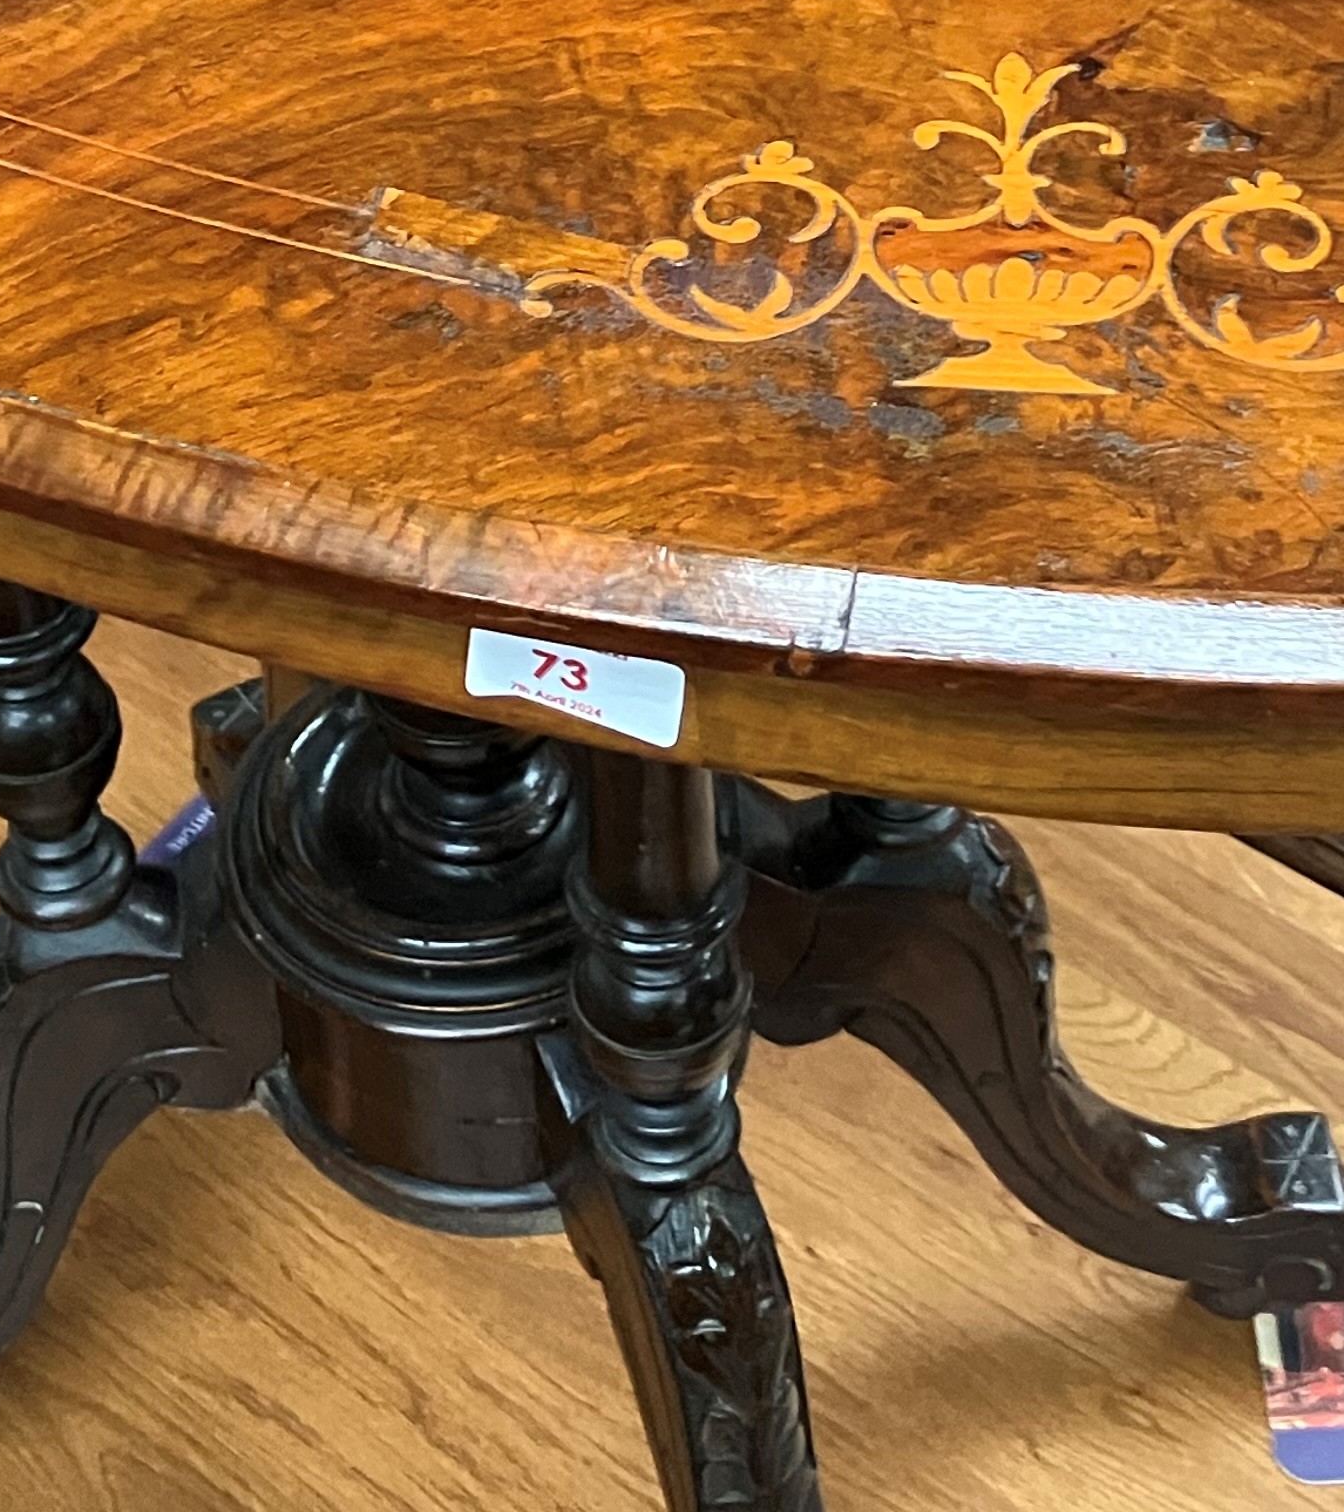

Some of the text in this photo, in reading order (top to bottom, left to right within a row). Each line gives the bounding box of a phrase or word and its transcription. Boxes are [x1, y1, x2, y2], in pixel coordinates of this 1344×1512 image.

[532, 648, 588, 692] 73
[510, 680, 603, 719] 7th April 2024
[164, 806, 216, 854] NITURE
